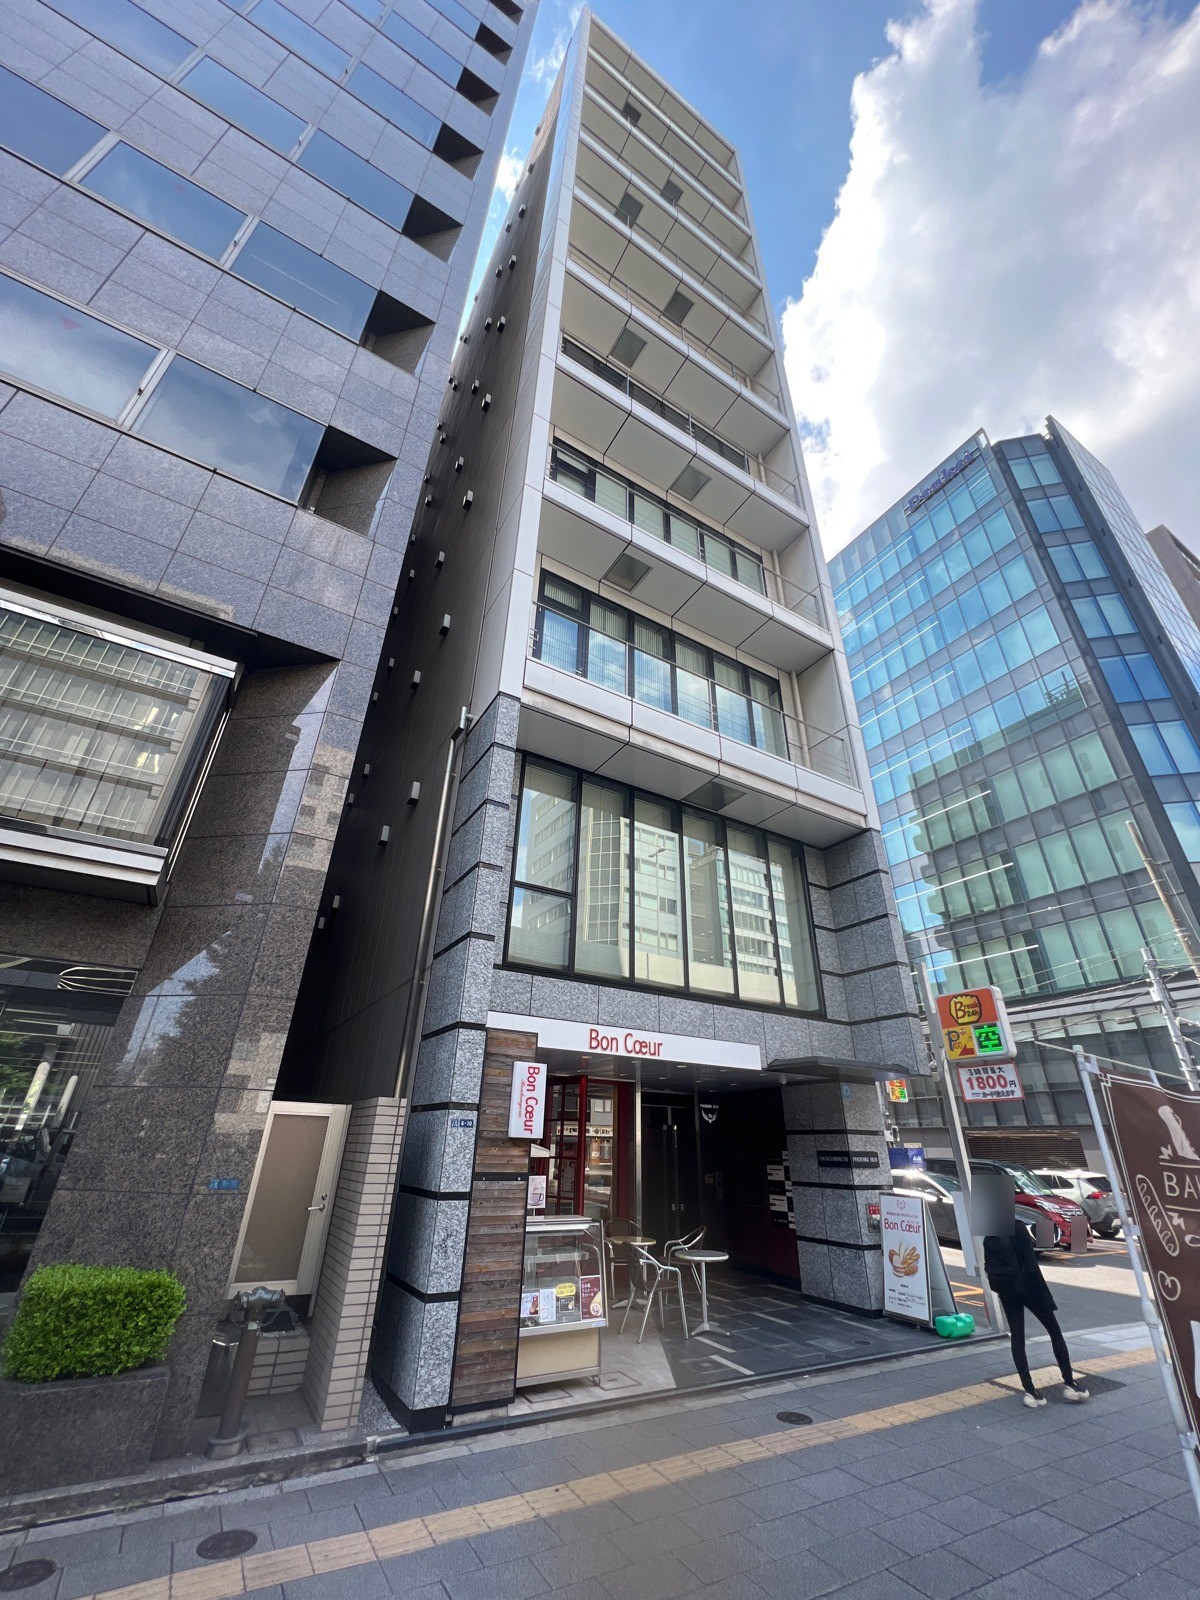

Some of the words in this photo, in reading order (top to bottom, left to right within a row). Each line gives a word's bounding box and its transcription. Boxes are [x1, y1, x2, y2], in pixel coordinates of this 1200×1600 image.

[954, 1000, 980, 1020] Break
[967, 1008, 979, 1017] 24h
[588, 1028, 619, 1053] Bon
[624, 1032, 663, 1057] Cœur
[974, 1025, 1004, 1053] 空
[526, 1066, 541, 1092] Bon
[967, 1066, 1006, 1076] 3時間最大
[966, 1074, 1017, 1090] 1800円
[523, 1096, 539, 1135] Cœur
[884, 1217, 899, 1231] Bon
[900, 1219, 922, 1234] Cœur
